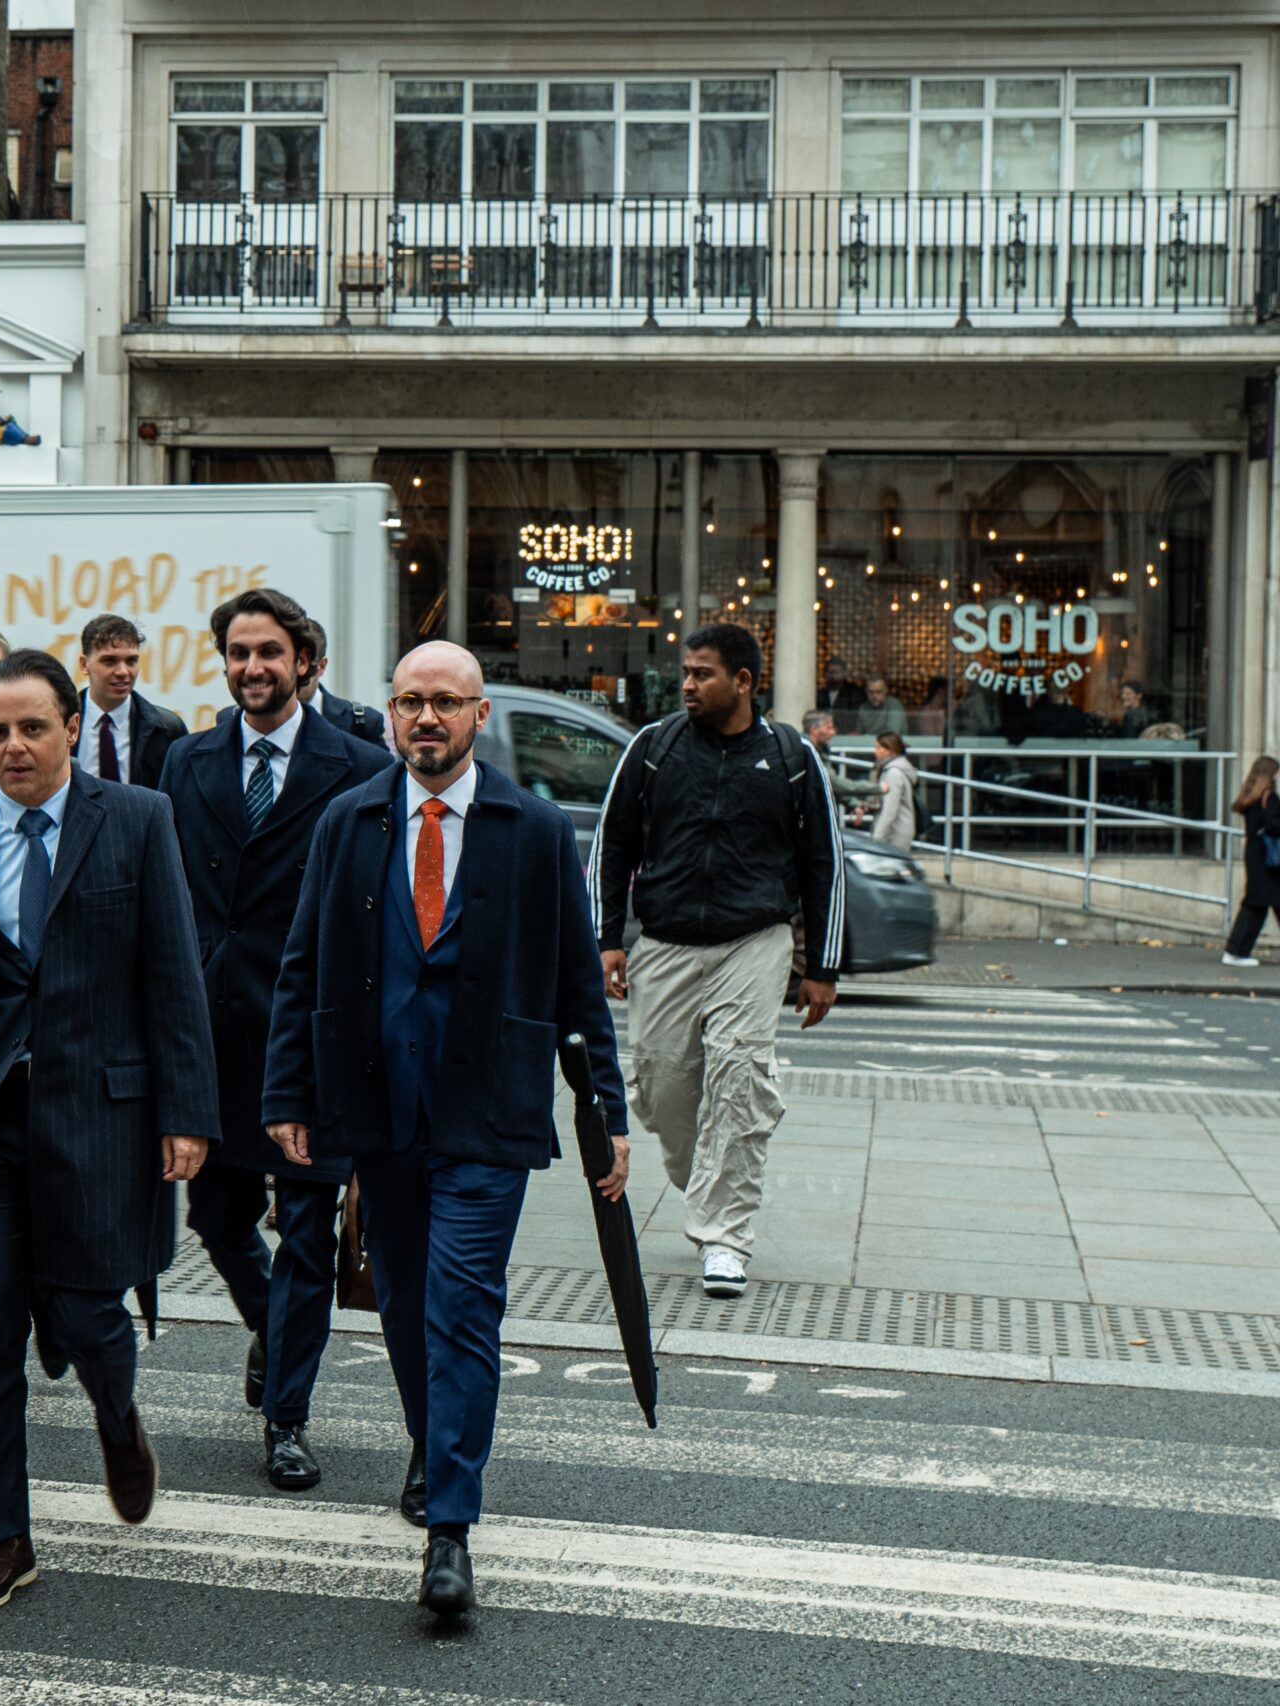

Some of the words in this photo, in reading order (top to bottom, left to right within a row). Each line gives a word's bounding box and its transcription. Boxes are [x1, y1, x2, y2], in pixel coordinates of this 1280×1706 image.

[192, 564, 269, 613] THE
[526, 566, 585, 592] COFFEE
[951, 603, 1099, 655] SOHO
[964, 661, 1047, 696] COFFEE
